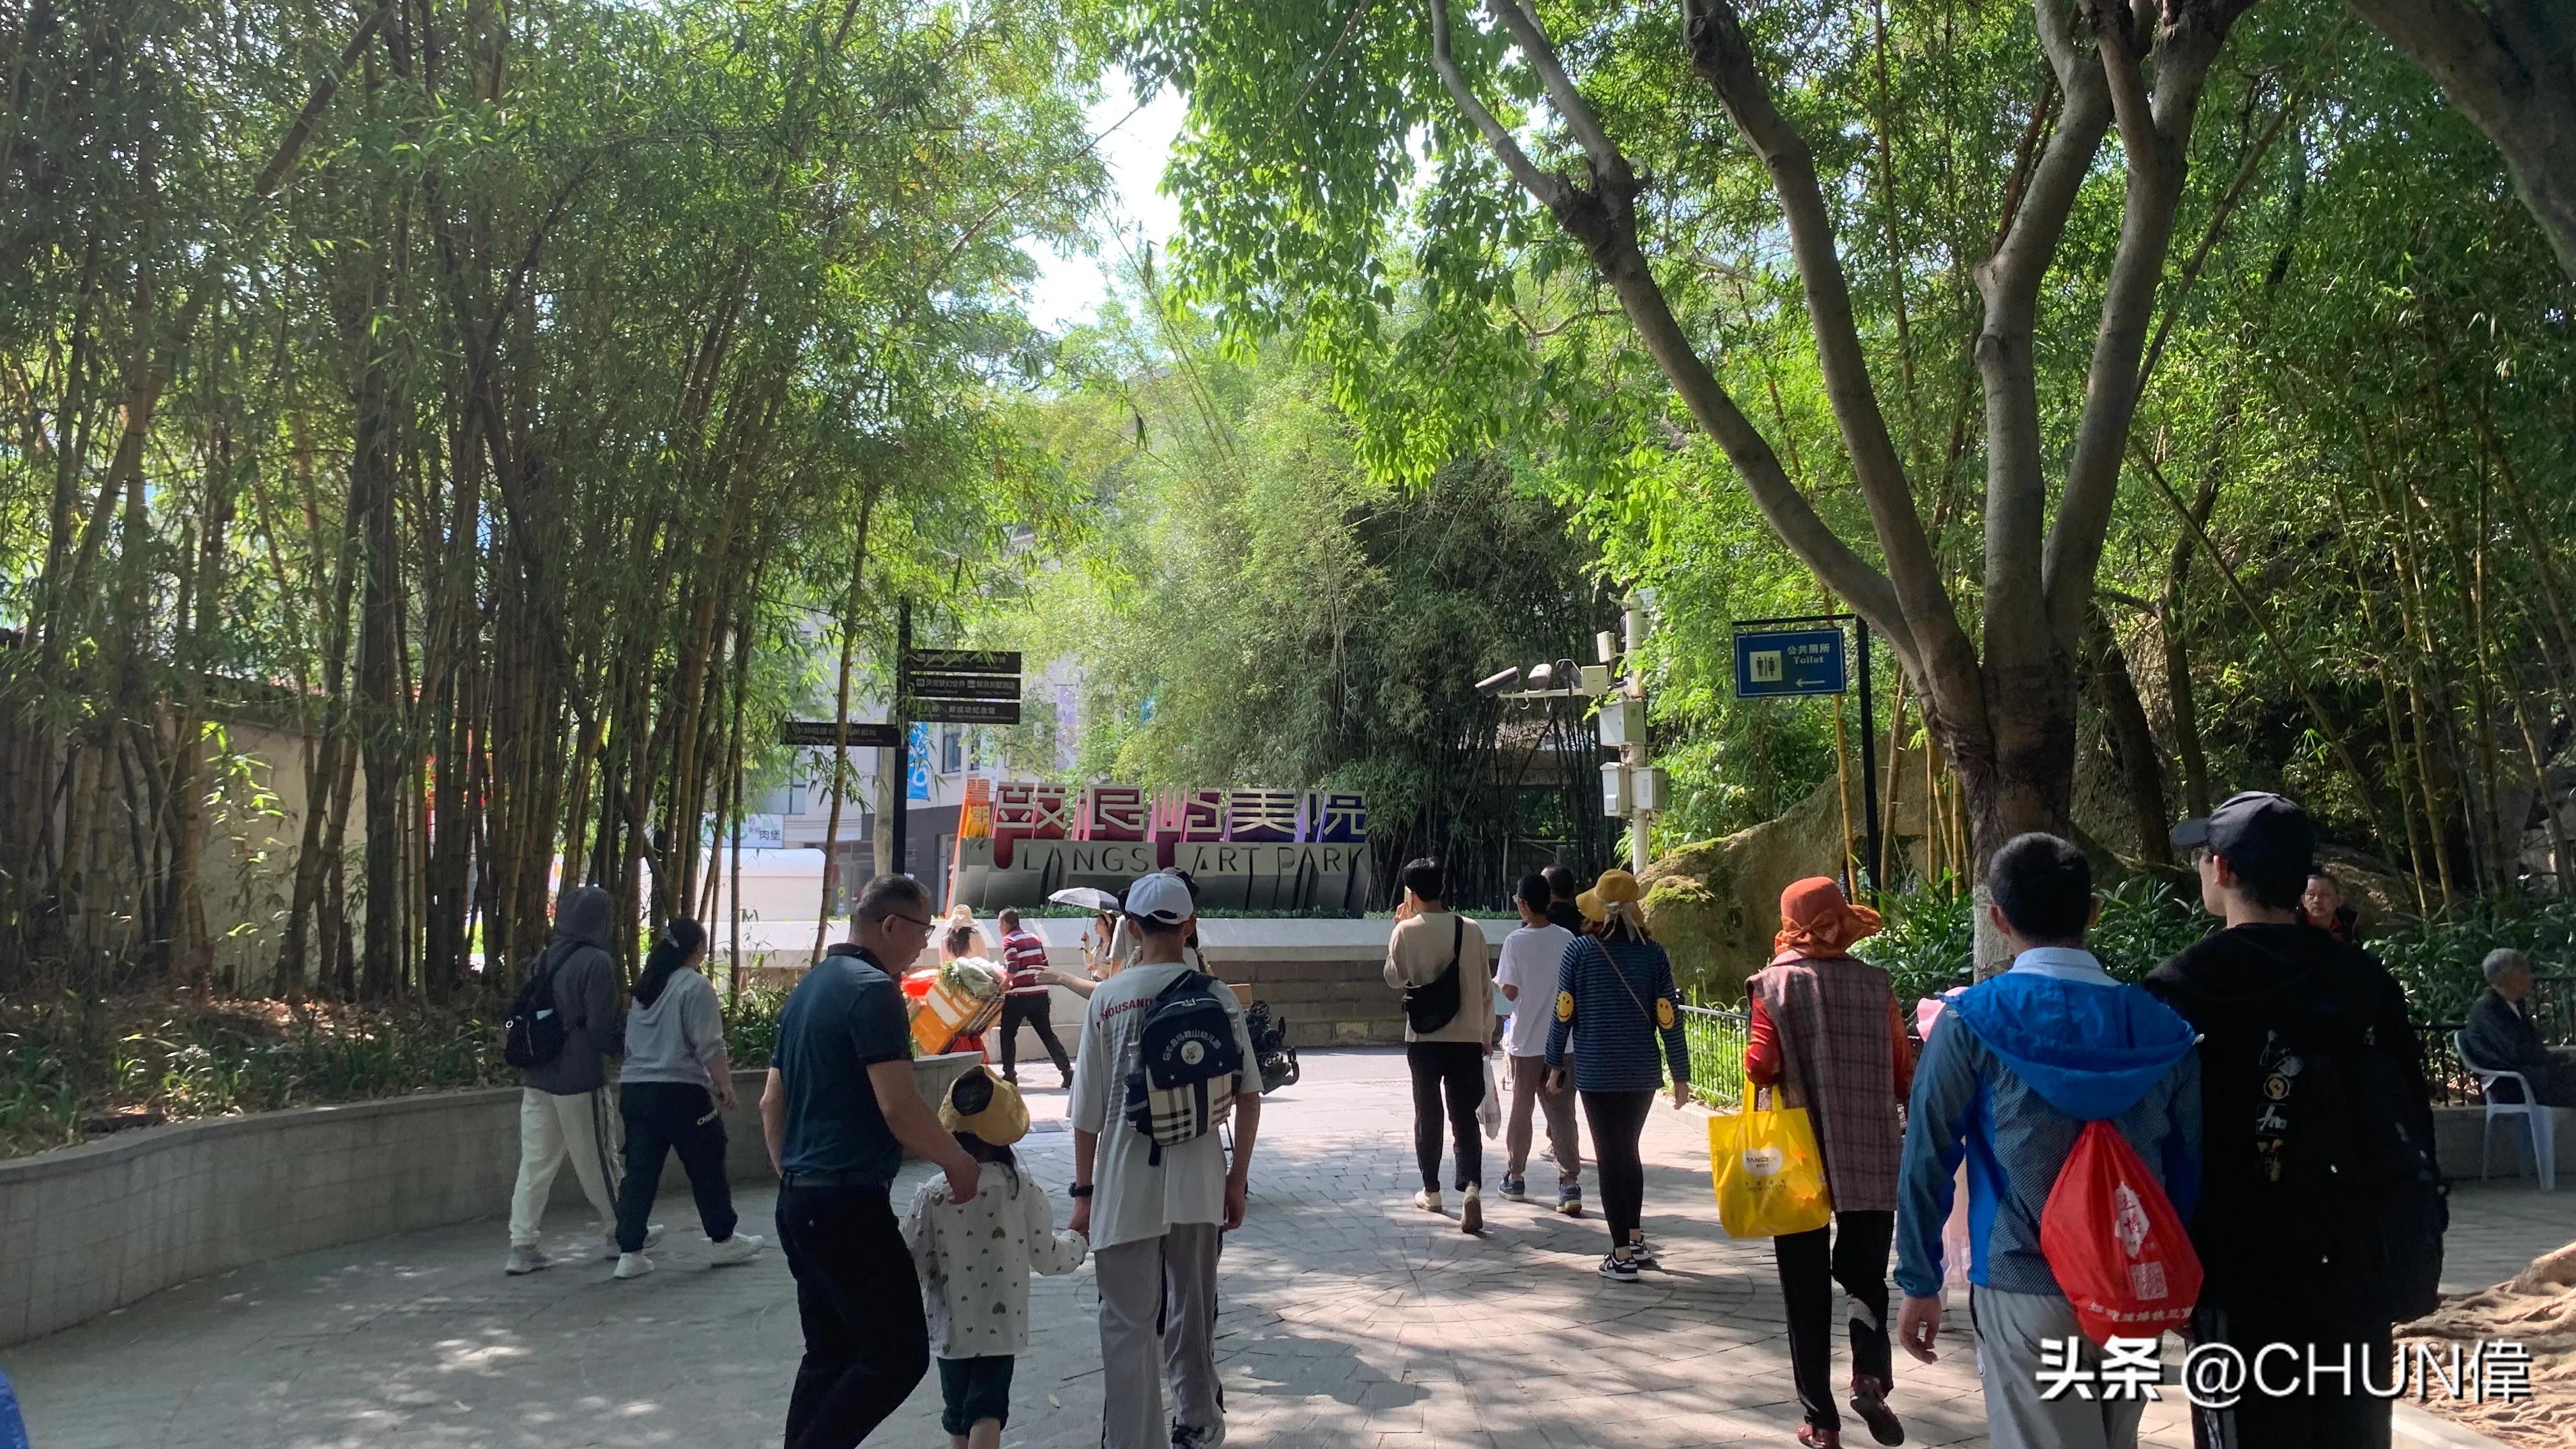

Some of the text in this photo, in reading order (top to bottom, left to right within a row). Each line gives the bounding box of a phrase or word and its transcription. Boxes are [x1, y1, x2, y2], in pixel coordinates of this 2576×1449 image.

[1787, 643, 1830, 655] 公共厕所
[1793, 656, 1824, 665] Toilet
[995, 781, 1367, 836] 鼓浪屿美院
[1190, 845, 1261, 873] ART
[1277, 845, 1364, 873] PARK
[1100, 998, 1153, 1021] HOUSAND
